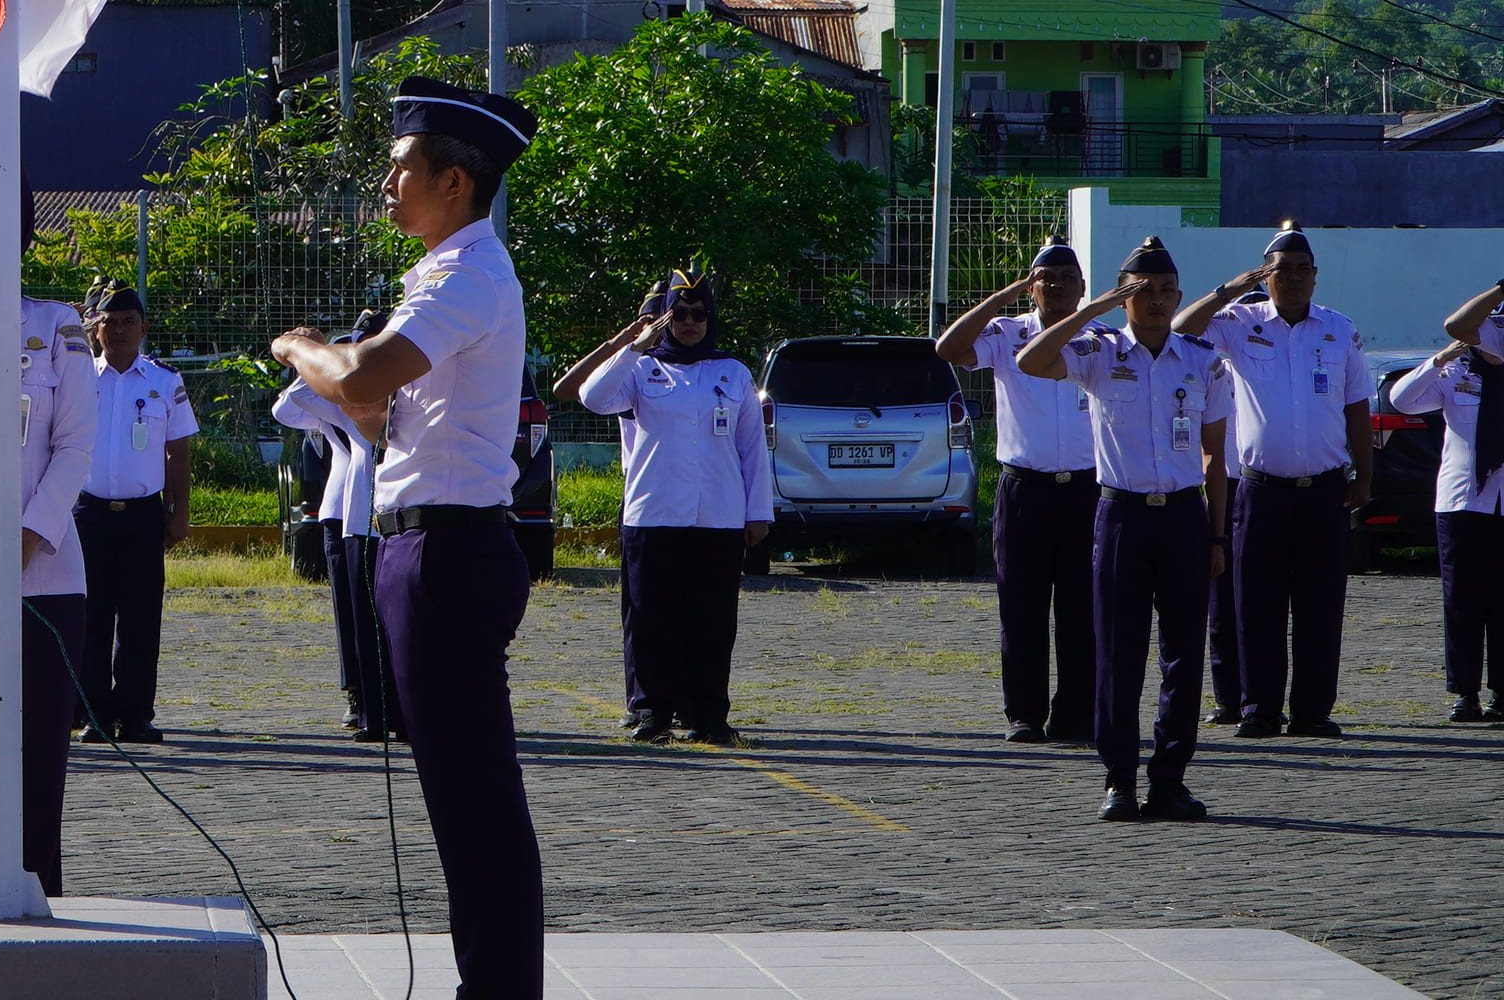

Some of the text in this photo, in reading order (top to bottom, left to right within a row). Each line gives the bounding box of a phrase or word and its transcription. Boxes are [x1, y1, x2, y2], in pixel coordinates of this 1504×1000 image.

[830, 446, 893, 458] DD 1261 VP
